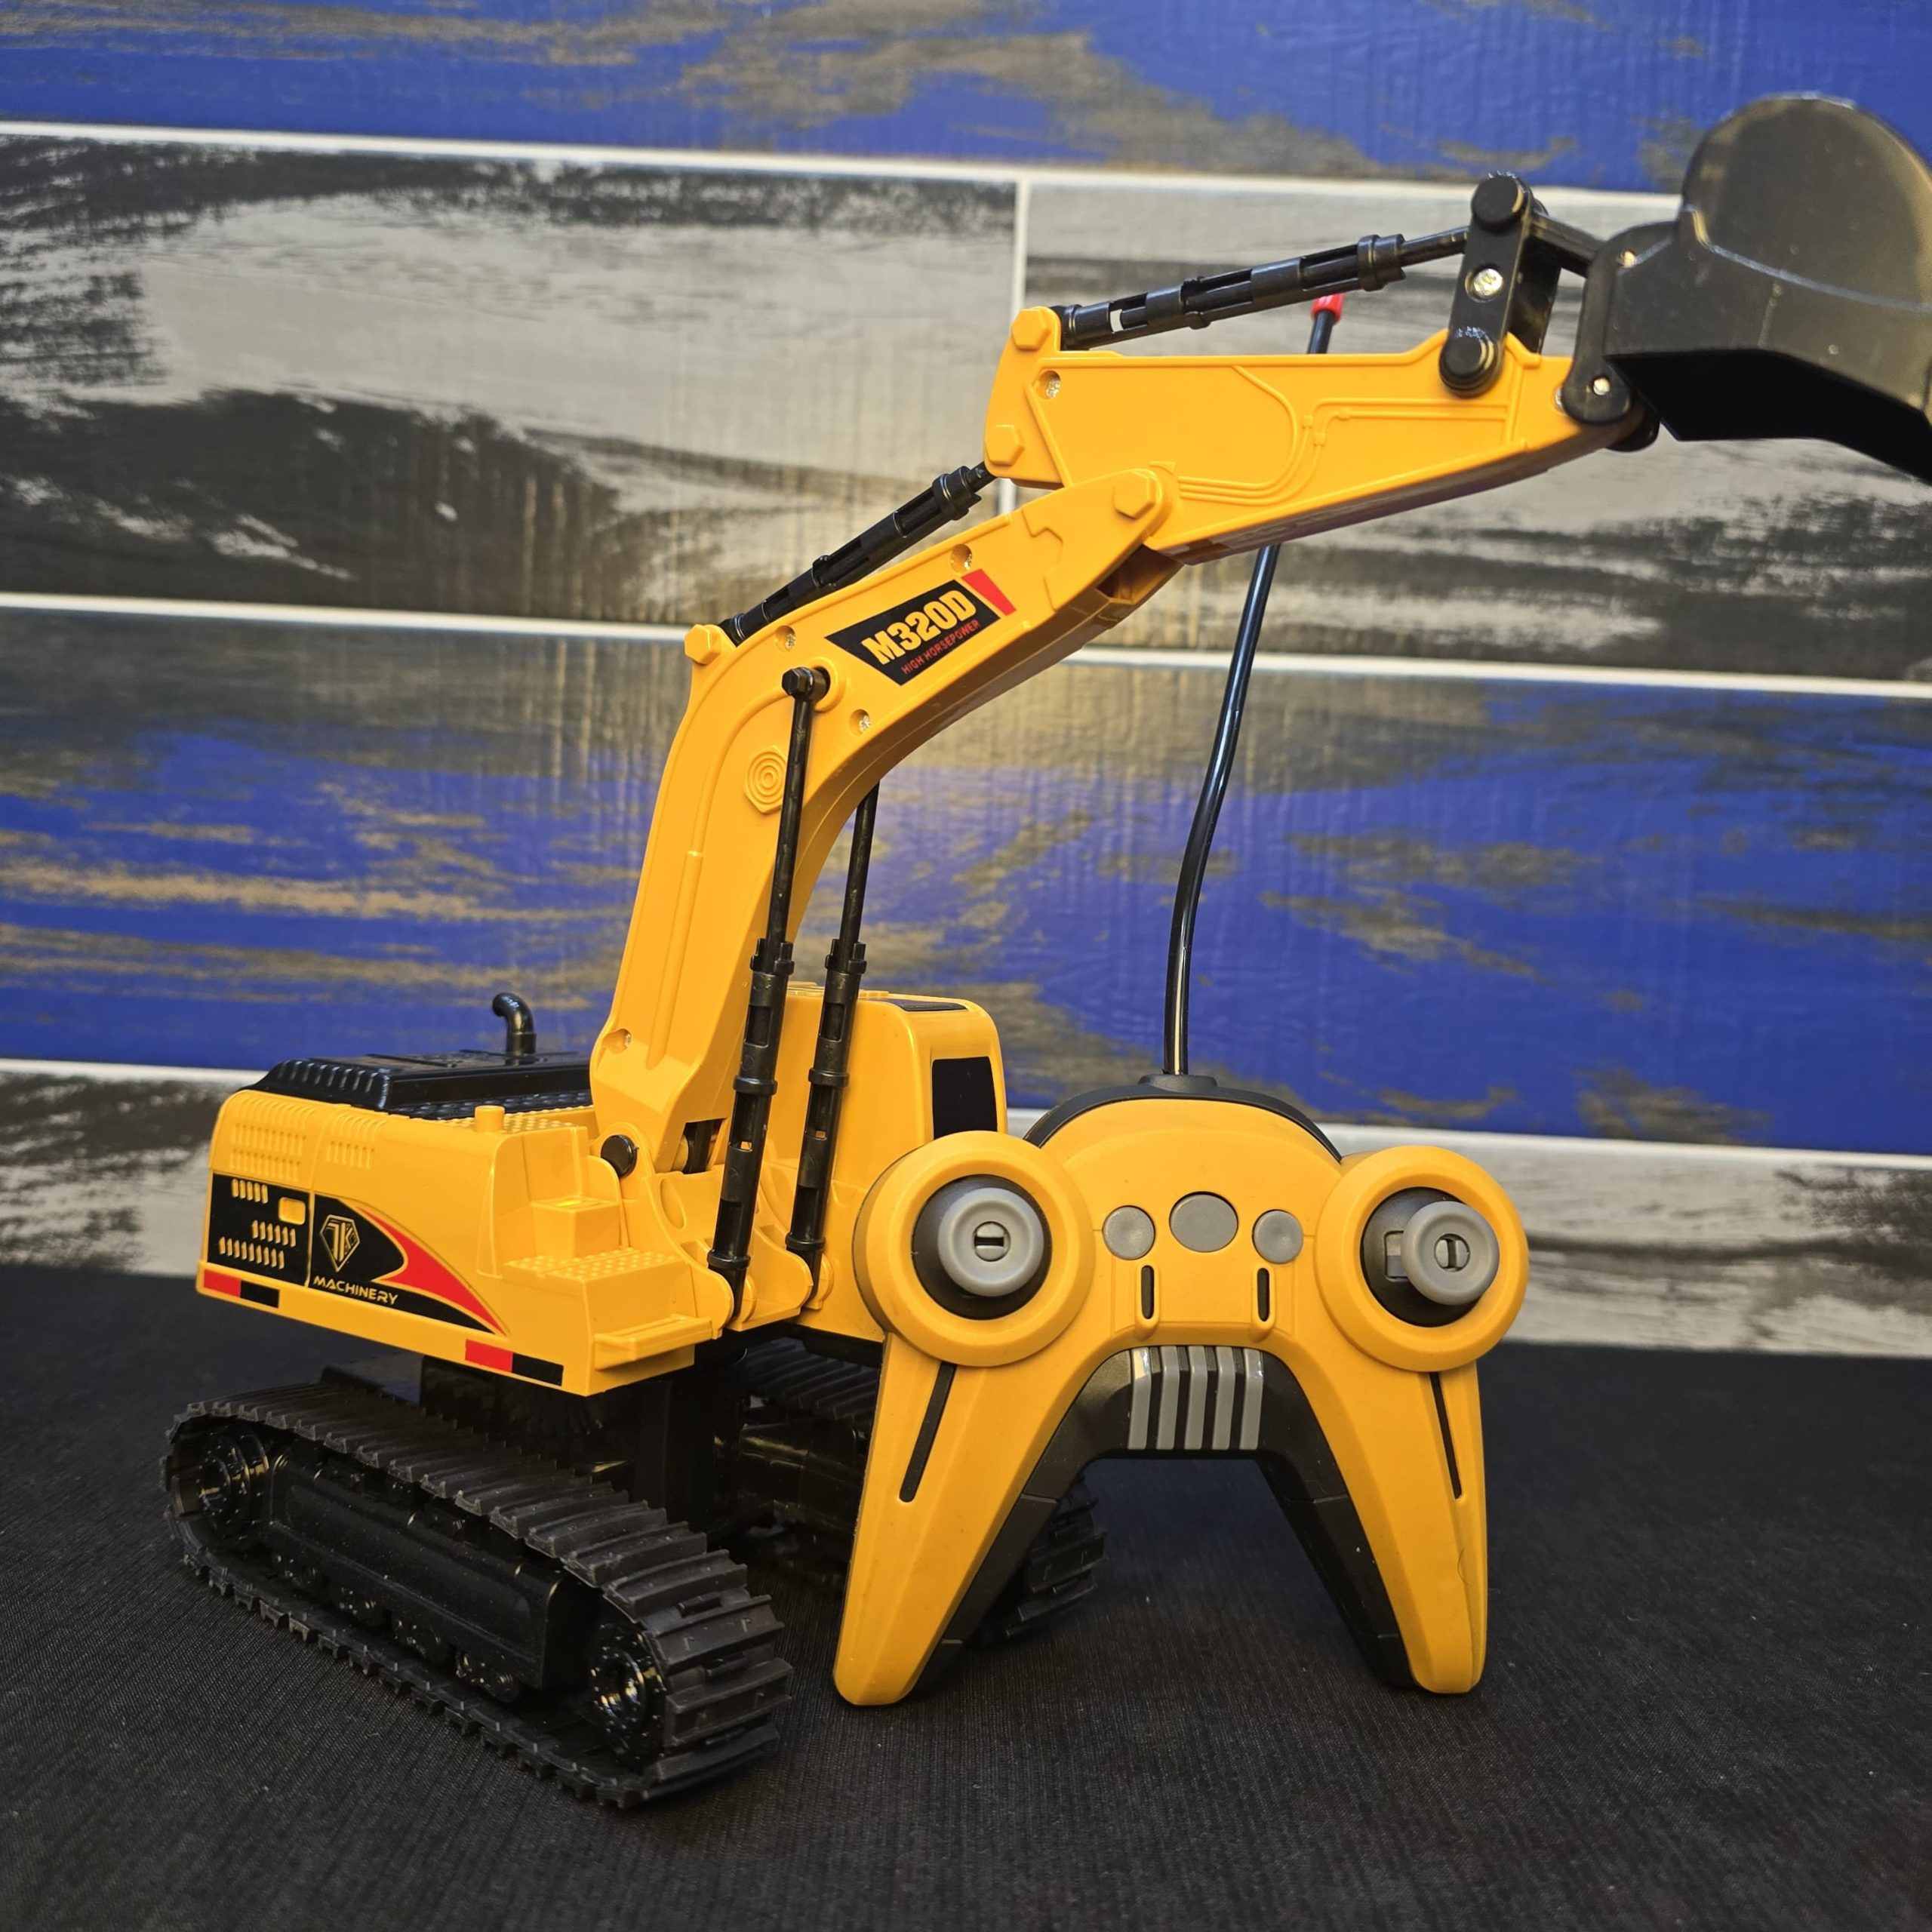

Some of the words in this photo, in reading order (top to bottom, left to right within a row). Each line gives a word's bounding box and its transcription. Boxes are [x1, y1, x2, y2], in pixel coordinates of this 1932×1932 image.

[861, 589, 977, 665] M320D
[900, 655, 925, 674] HIGH
[923, 619, 980, 660] HORSEPOWER
[313, 1275, 398, 1305] MACHINERY
